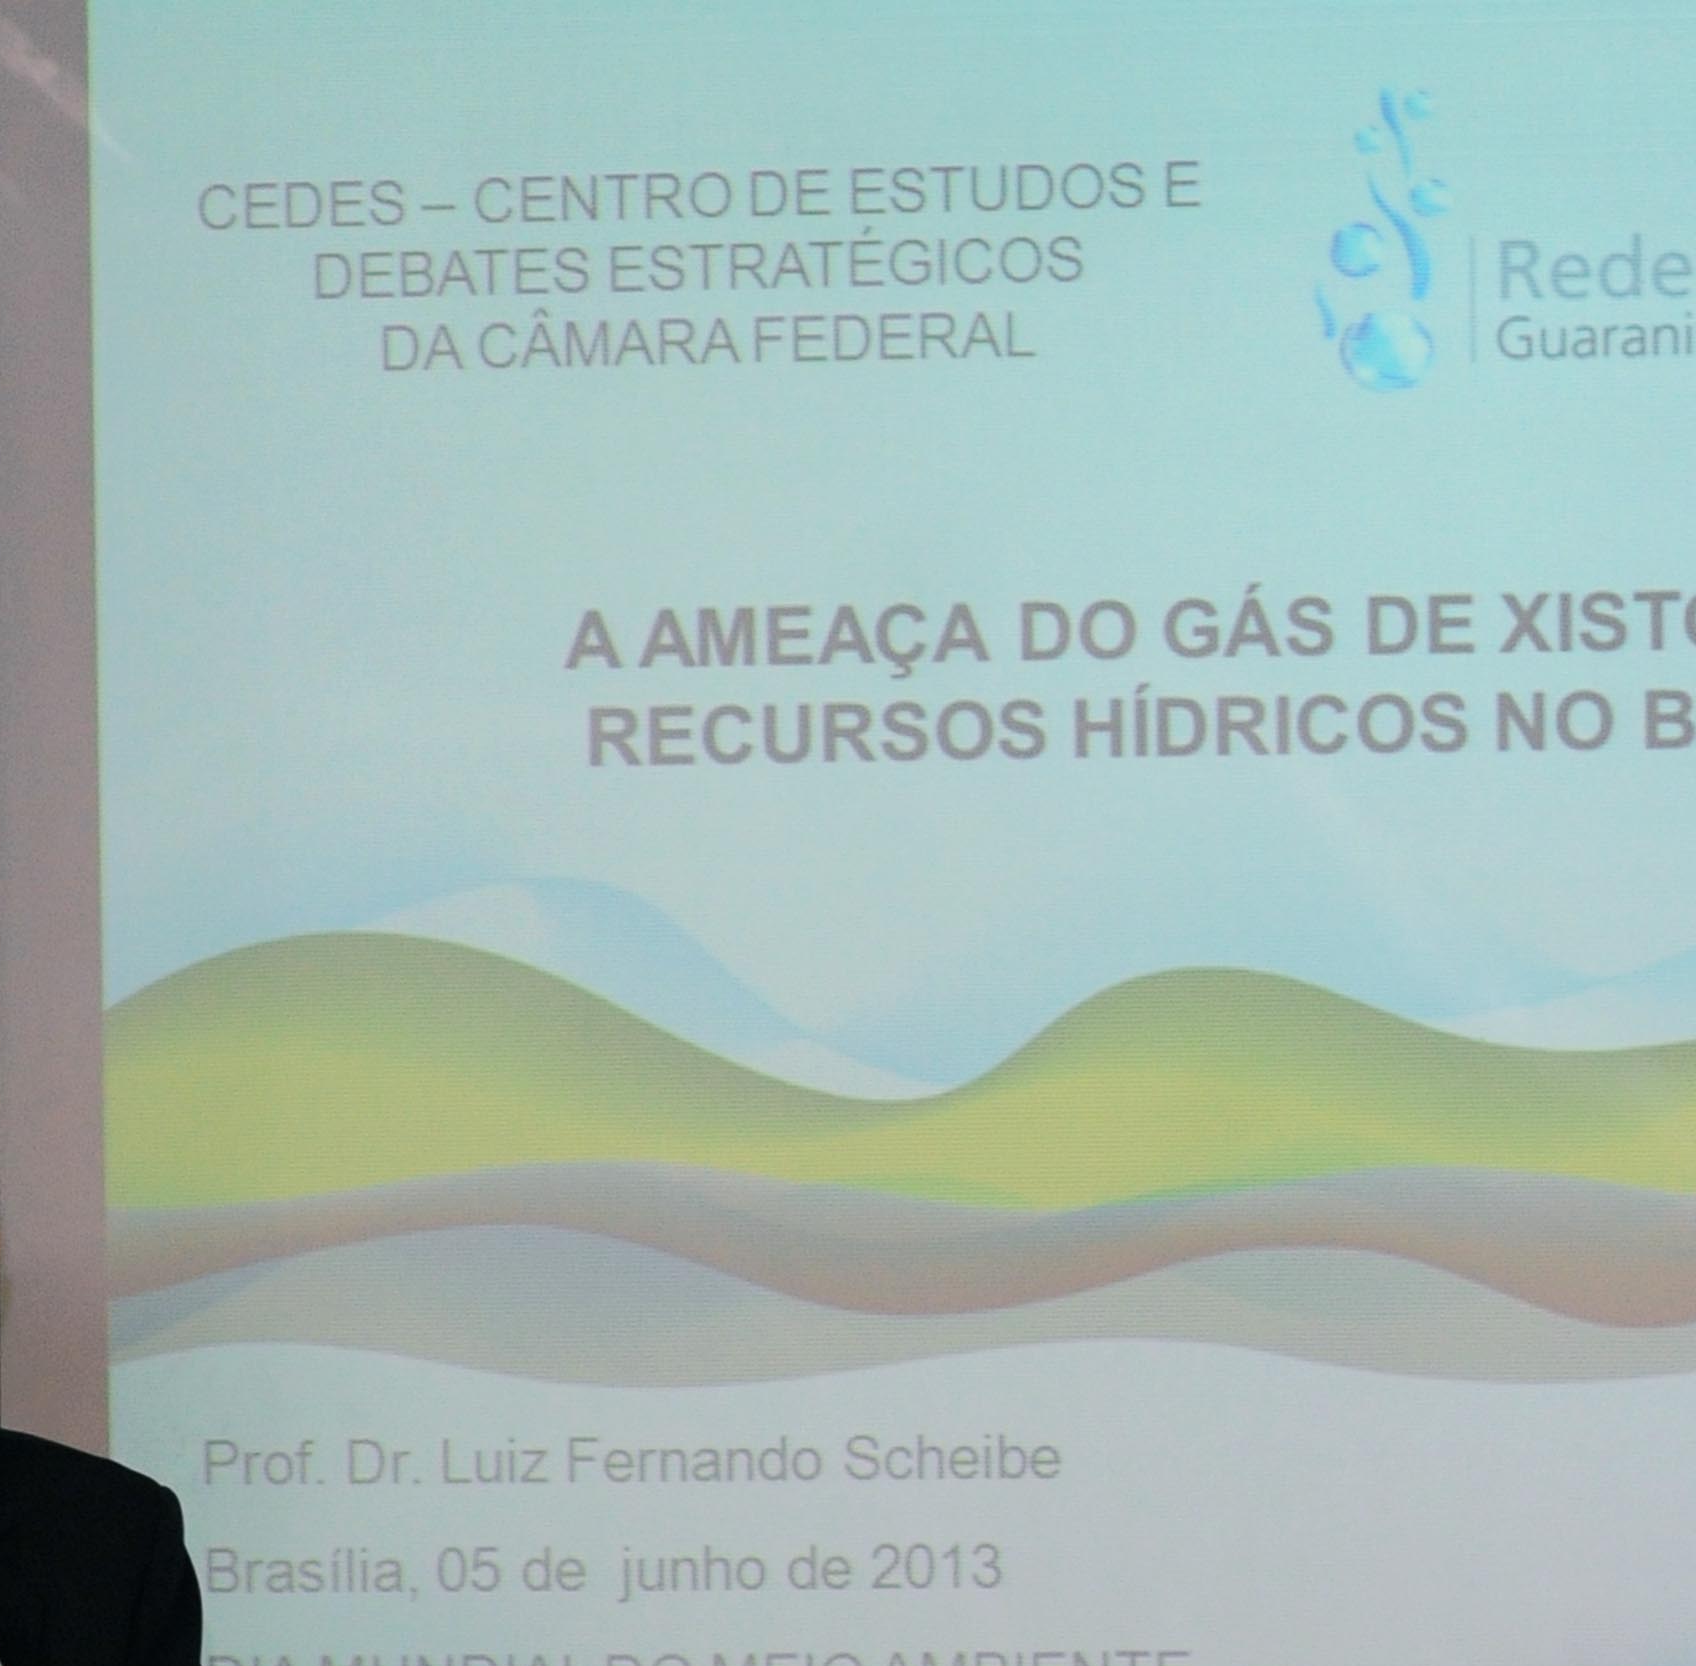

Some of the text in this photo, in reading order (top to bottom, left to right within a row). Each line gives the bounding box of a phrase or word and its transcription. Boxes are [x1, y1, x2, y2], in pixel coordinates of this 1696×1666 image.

[198, 180, 405, 231] CEDES
[474, 171, 733, 224] CENTRO
[750, 168, 830, 217] DE
[850, 162, 1145, 215] ESTUDOS
[1165, 160, 1200, 208] E
[314, 226, 1083, 300] DEBATES ESTRATÉGICOS
[1500, 232, 1693, 300] Rede
[382, 307, 1035, 372] DA CÂMARA FEDERAL
[1495, 312, 1695, 361] Guarani
[565, 610, 622, 669] A
[639, 603, 989, 680] AMEAÇA
[1021, 600, 1136, 661] DO
[1164, 583, 1334, 658] GÁS
[1368, 594, 1475, 655] DE
[589, 699, 1046, 767] RECURSOS
[1074, 683, 1468, 758] HÍDRICOS
[1497, 690, 1614, 751] NO
[203, 1434, 1062, 1487] Prof. Dr. Luiz Fernando Scheibe
[207, 1542, 1003, 1604] Brasília, 05 de junho de 2013
